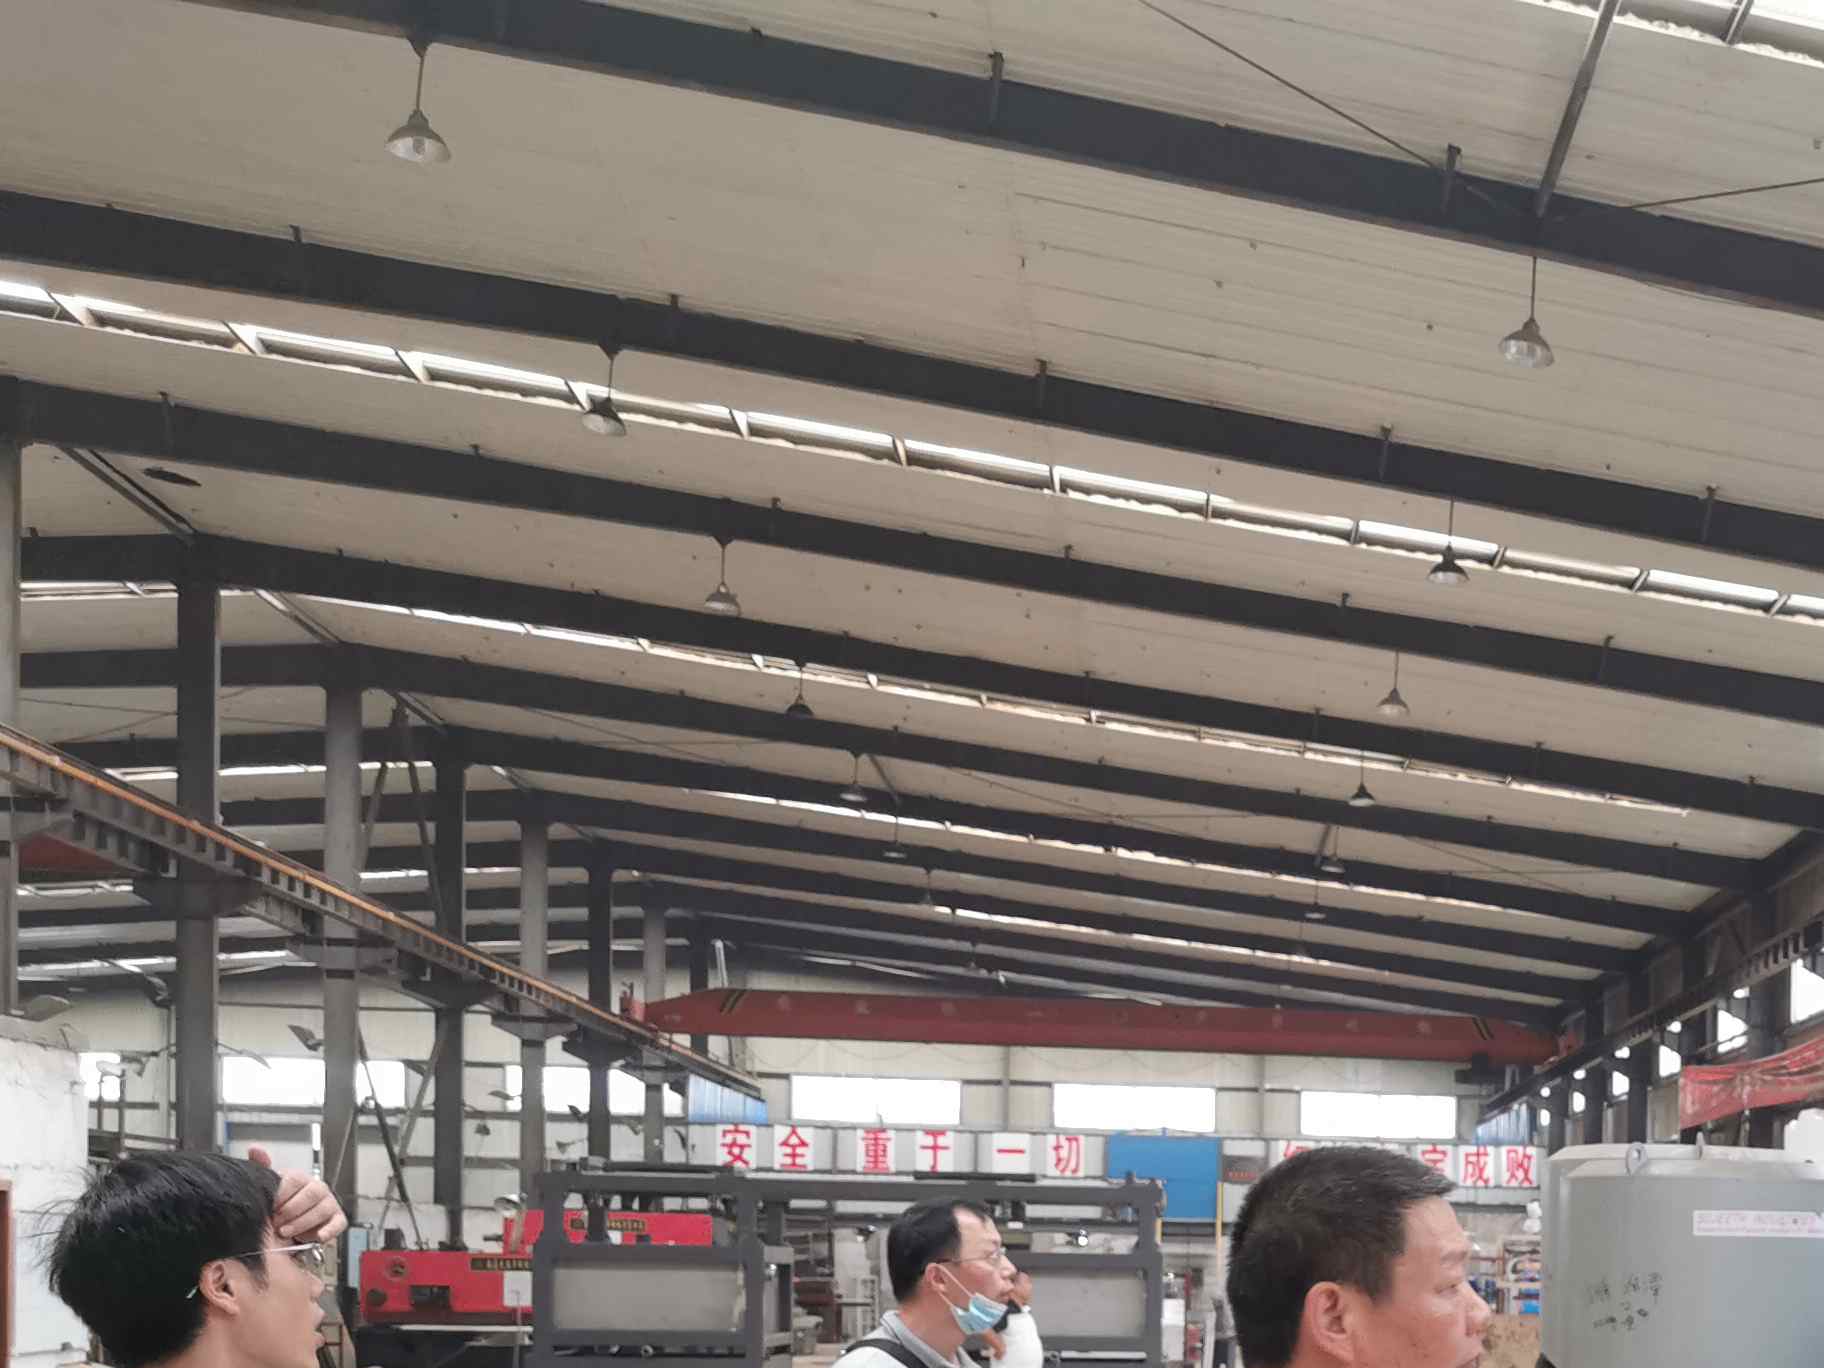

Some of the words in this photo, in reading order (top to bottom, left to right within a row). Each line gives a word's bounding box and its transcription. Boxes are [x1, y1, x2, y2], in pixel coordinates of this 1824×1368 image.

[720, 1123, 1082, 1175] 安全重于一切
